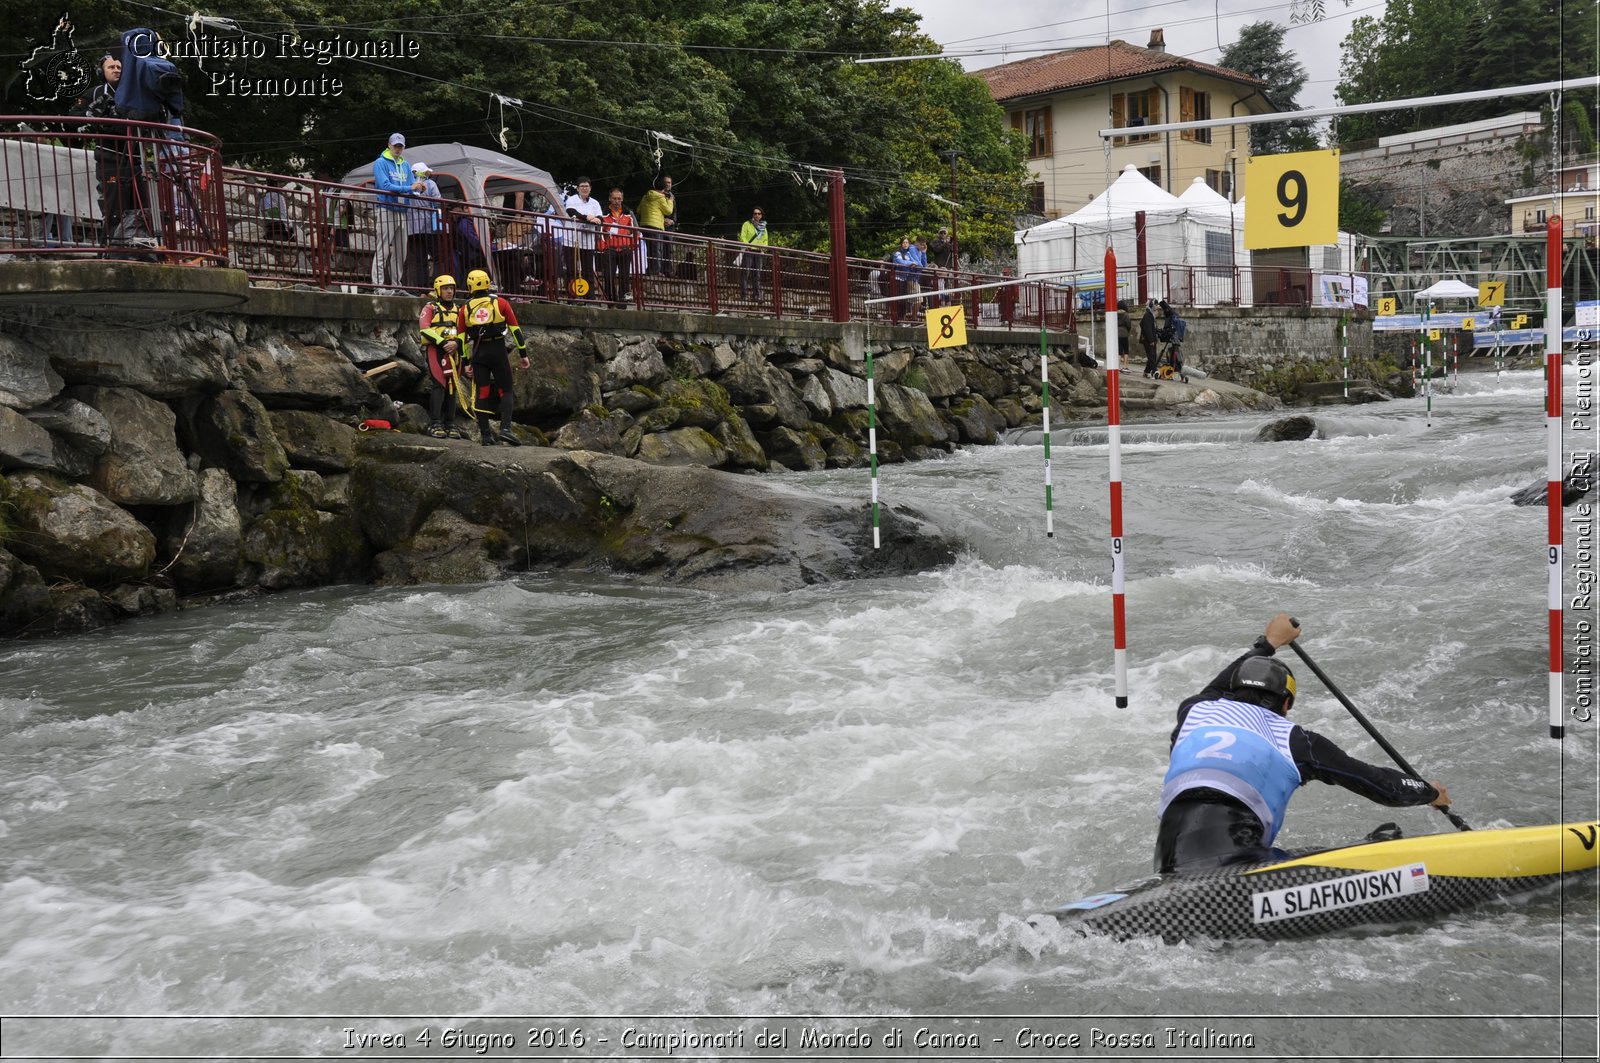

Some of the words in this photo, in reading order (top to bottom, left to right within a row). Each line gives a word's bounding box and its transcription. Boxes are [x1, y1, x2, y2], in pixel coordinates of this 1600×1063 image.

[1276, 170, 1308, 228] 9
[1487, 286, 1497, 301] 7
[1383, 301, 1390, 312] 6
[940, 314, 954, 339] 8
[1113, 538, 1121, 554] 9
[1548, 546, 1558, 565] 9
[1195, 731, 1237, 760] 2
[1260, 896, 1279, 920] A.
[1284, 870, 1402, 915] SLAFKOVSKY
